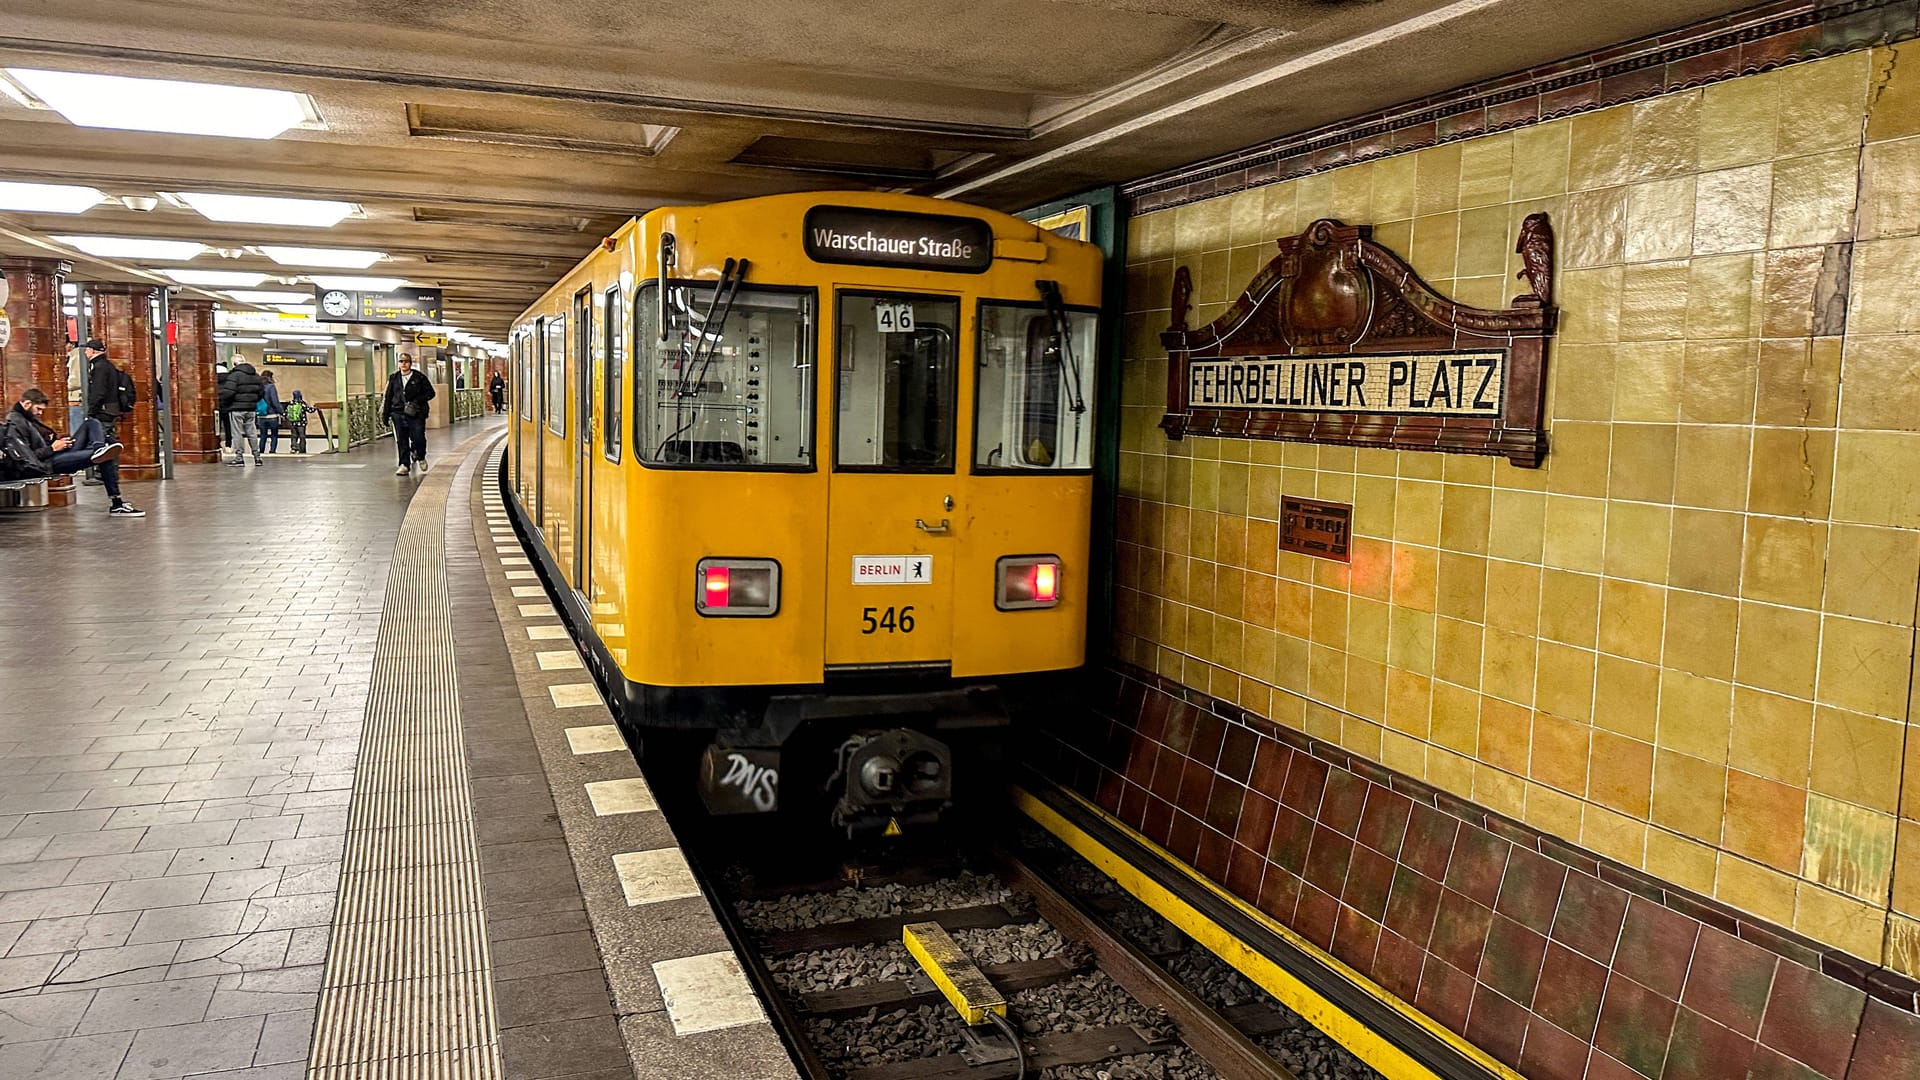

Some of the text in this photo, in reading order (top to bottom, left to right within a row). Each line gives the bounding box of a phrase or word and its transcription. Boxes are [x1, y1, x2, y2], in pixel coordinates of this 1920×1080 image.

[813, 228, 973, 260] Warschauer Straße
[1191, 359, 1497, 409] FEHRBELLINER PLATZ
[859, 564, 902, 576] BERLIN
[861, 606, 915, 634] 546
[720, 753, 778, 812] DNS
